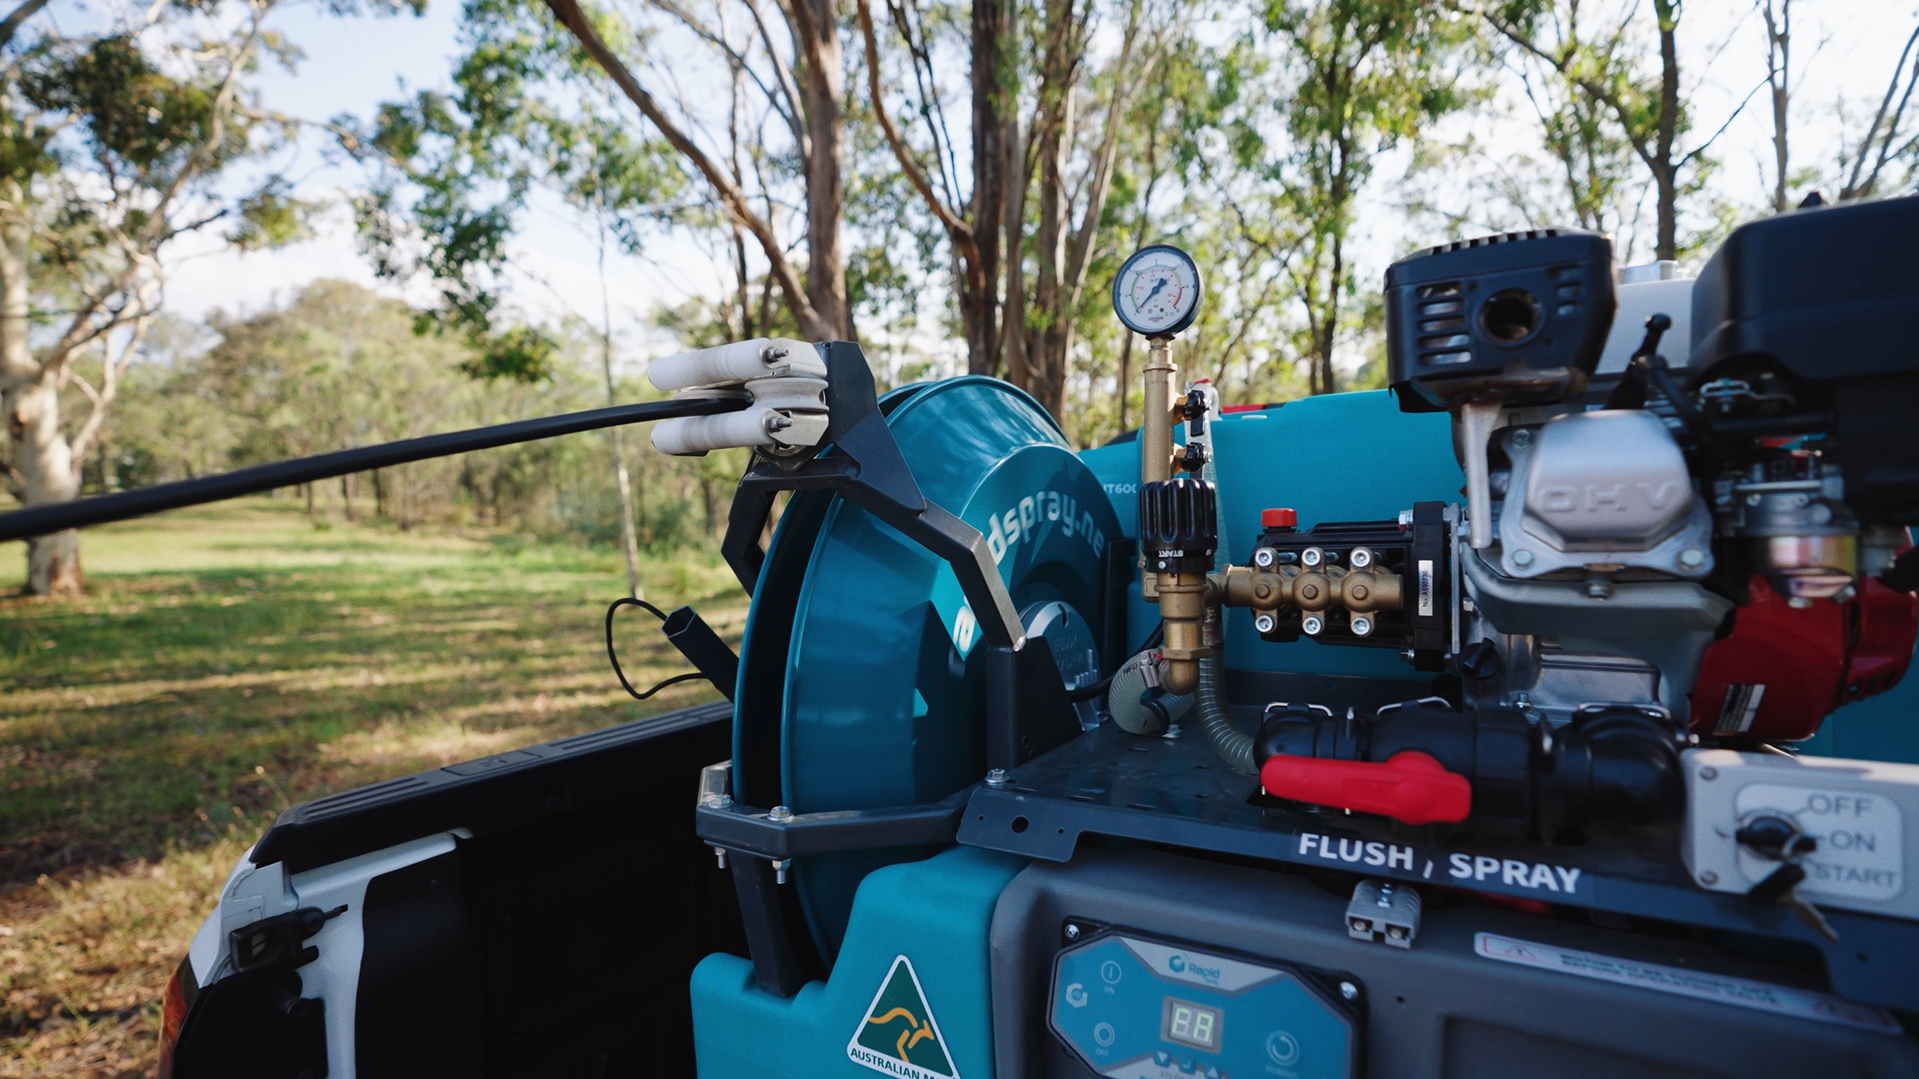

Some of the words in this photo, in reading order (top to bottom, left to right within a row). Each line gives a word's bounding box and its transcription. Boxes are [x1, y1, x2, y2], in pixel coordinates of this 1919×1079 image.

[1540, 480, 1675, 512] OHV
[1158, 549, 1184, 558] START
[1808, 793, 1873, 818] OFF
[1830, 828, 1876, 853] ON
[1298, 832, 1415, 872] FLUSH
[1447, 851, 1582, 895] SPRAY
[1814, 862, 1896, 888] START
[1188, 963, 1220, 979] Rapid
[850, 1047, 920, 1079] AUSTRALIAN
